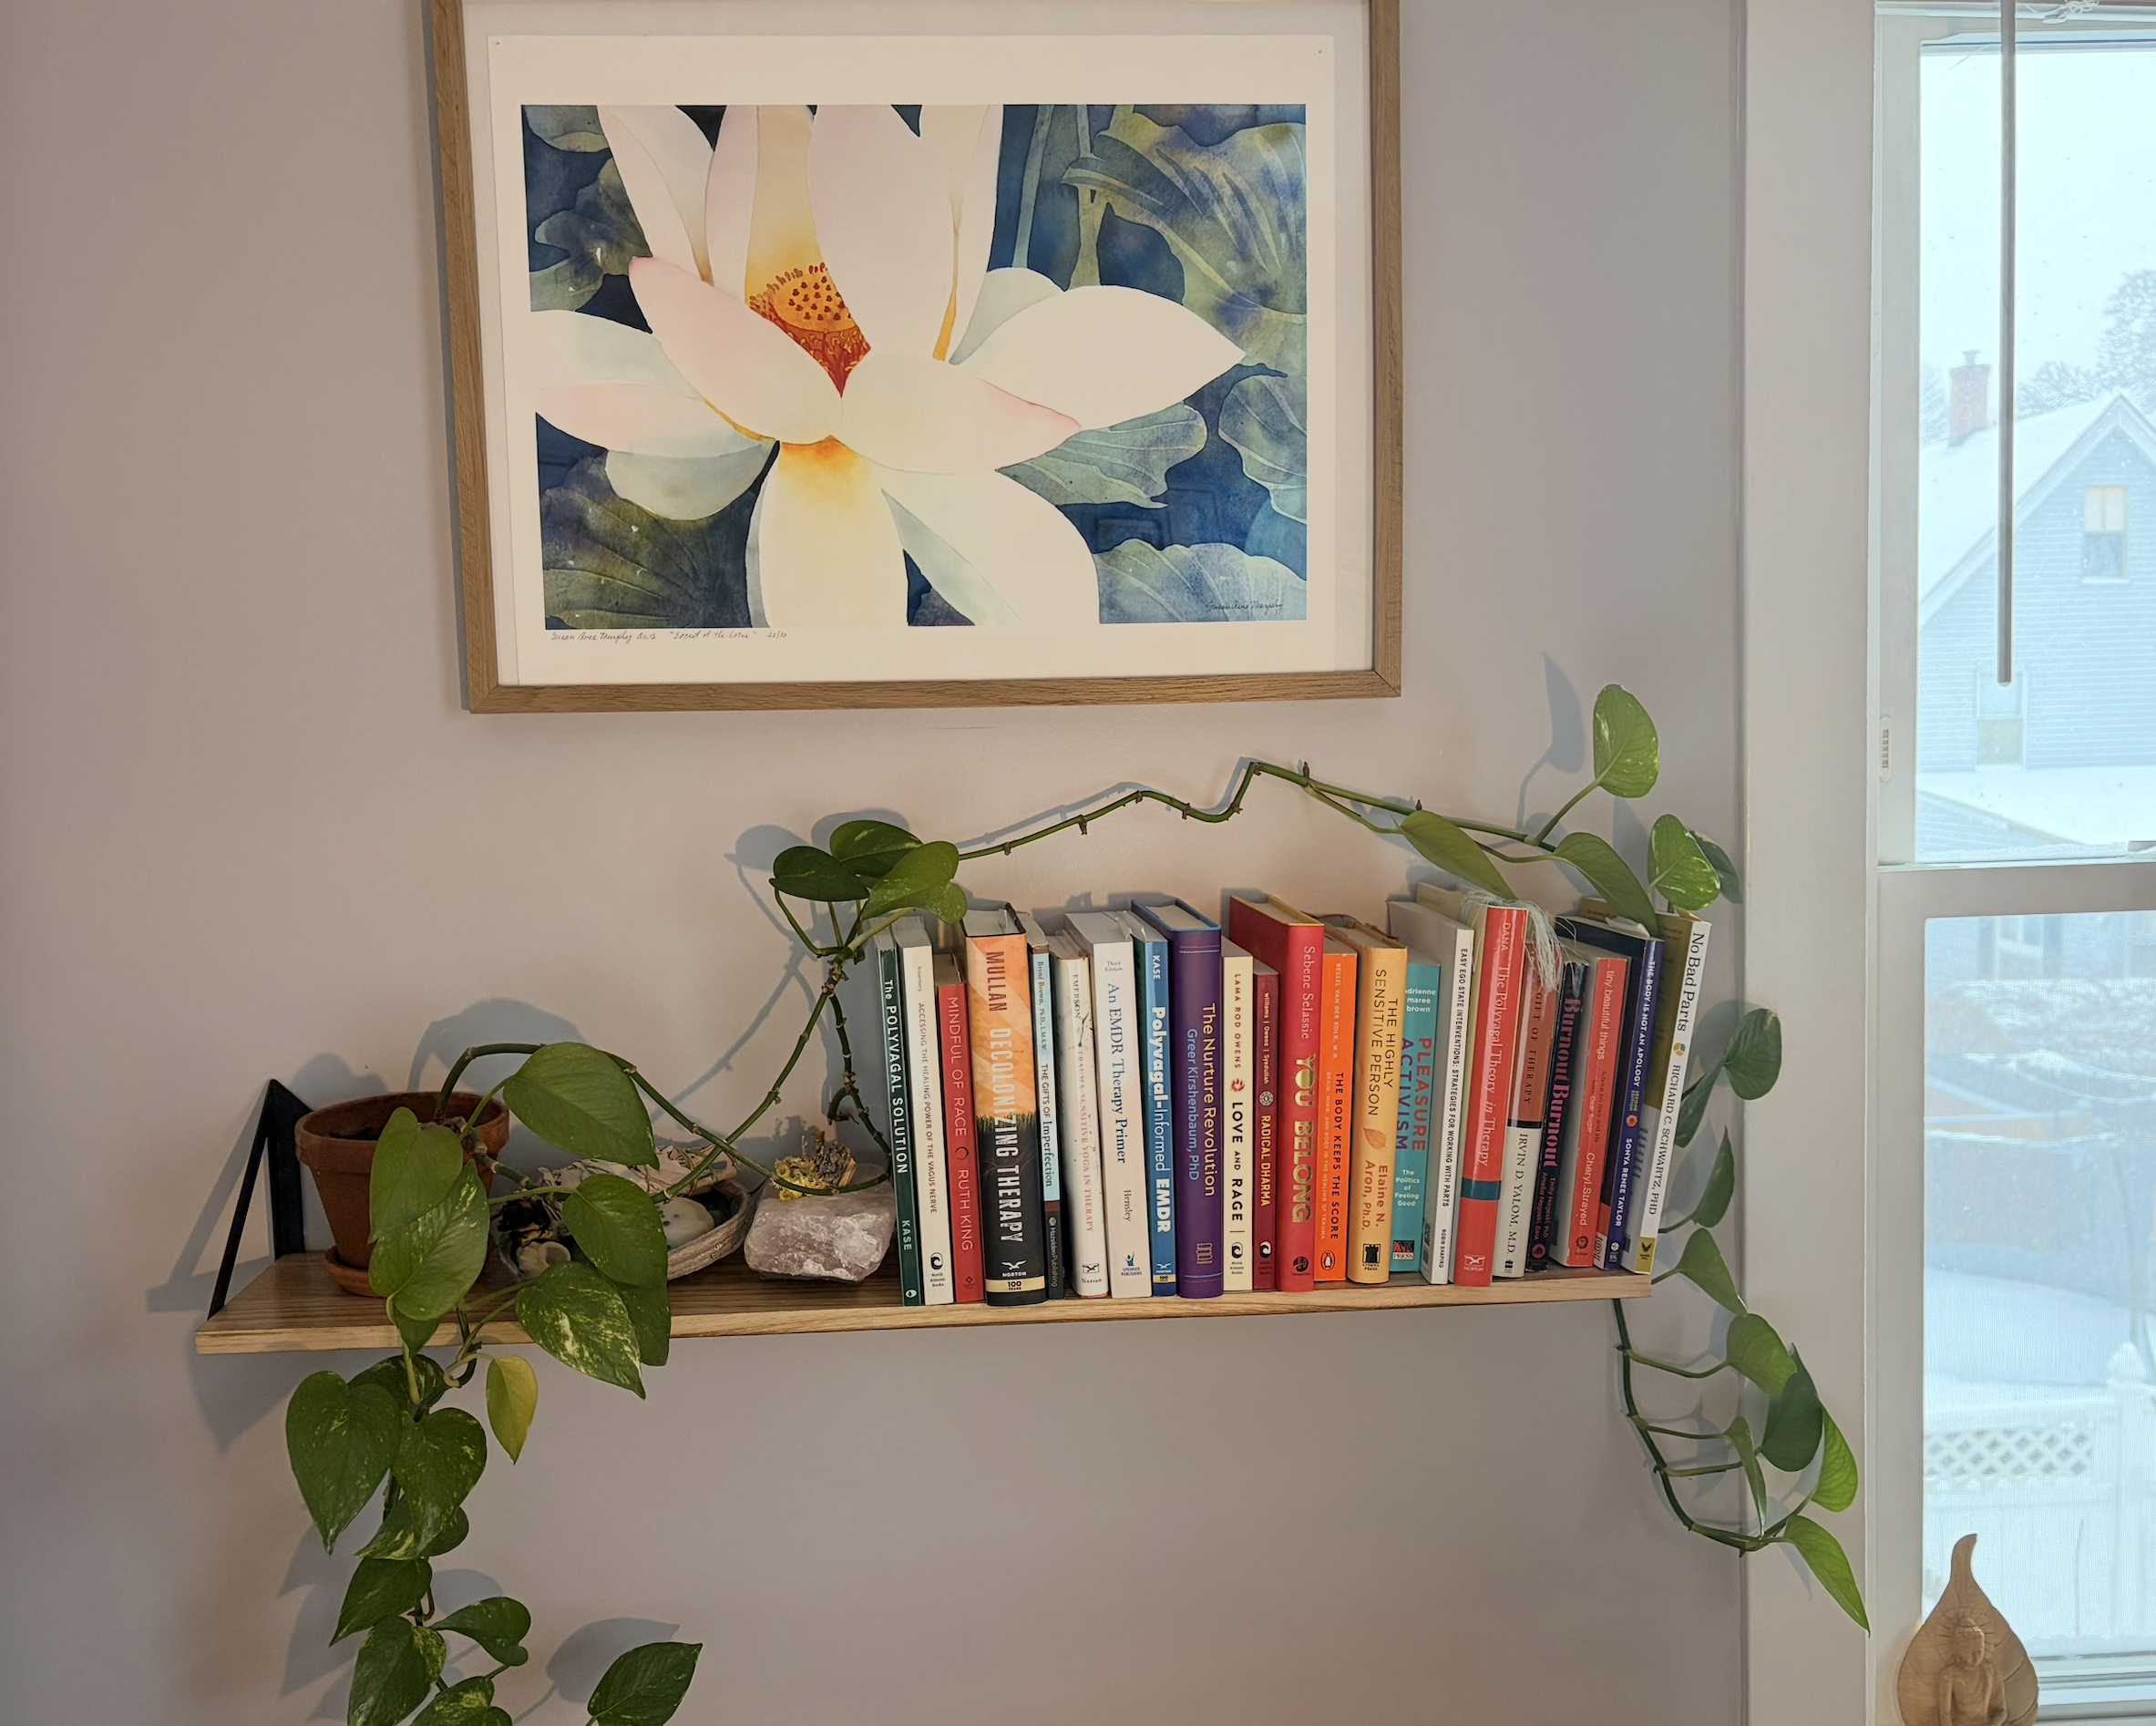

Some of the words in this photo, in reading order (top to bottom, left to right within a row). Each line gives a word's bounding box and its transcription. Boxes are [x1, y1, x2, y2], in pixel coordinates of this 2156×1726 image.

[1500, 921, 1511, 951] DANA
[1689, 932, 1705, 954] No
[1152, 954, 1161, 980] KASE
[1302, 946, 1316, 989] Sebene
[1460, 948, 1468, 968] EASY
[1496, 962, 1510, 989] The
[1648, 960, 1656, 978] THE
[1685, 957, 1700, 987] Bad
[883, 980, 894, 1000] The
[986, 951, 1007, 1012] MULLAN
[1107, 982, 1120, 1003] An
[1458, 969, 1466, 984] EGO
[1604, 970, 1616, 988] tiny
[1644, 978, 1653, 1002] BODY
[1073, 974, 1082, 1019] EMERSON
[1371, 969, 1387, 1048] SENSITIVE
[1386, 998, 1399, 1027] THE
[1456, 986, 1465, 1008] STATE
[1534, 992, 1543, 1020] GIFT
[1601, 989, 1614, 1030] beautiful
[1643, 1003, 1650, 1012] IS
[1677, 990, 1695, 1033] Parts
[918, 1002, 928, 1046] ACCESSING
[948, 997, 962, 1064] MINDFUL
[1109, 1007, 1124, 1054] EMDR
[1203, 1002, 1217, 1035] The
[1300, 992, 1315, 1040] Selassie
[1488, 992, 1508, 1047] Polyvagal
[1640, 1013, 1649, 1032] NOT
[886, 1005, 902, 1093] POLYVAGAL
[1187, 1028, 1197, 1064] Greer
[1453, 1009, 1463, 1067] INTERVENTIONS:
[1532, 1027, 1539, 1043] OF
[1554, 998, 1581, 1084] Burnout
[1596, 1032, 1608, 1060] things
[1638, 1033, 1646, 1046] AN
[920, 1048, 929, 1063] THE
[1041, 1063, 1049, 1080] THE
[1203, 1038, 1217, 1104] Nurture
[1383, 1033, 1396, 1088] HIGHLY
[1484, 1050, 1503, 1094] Theory
[1633, 1046, 1645, 1087] APOLOGY
[922, 1063, 930, 1100] HEALING
[951, 1069, 964, 1089] OF
[989, 1027, 1019, 1157] DECOLONIZING
[1042, 1082, 1050, 1105] GIFTS
[1111, 1058, 1125, 1114] Therapy
[1148, 1006, 1171, 1172] Polyvagal-Informed
[1294, 1053, 1316, 1107] YOU
[1335, 1072, 1344, 1094] THE
[1368, 1053, 1381, 1115] PERSON
[1396, 1037, 1414, 1150] ACTIVISM
[1450, 1069, 1459, 1112] STRATEGIES
[1524, 1049, 1537, 1104] THERAPY
[1666, 1064, 1681, 1114] RICHARD
[1042, 1106, 1051, 1118] OF
[1186, 1066, 1199, 1152] Kirshenbaum,
[1412, 1038, 1432, 1151] PLEASURE
[1484, 1100, 1496, 1114] in
[924, 1101, 932, 1130] POWER
[953, 1097, 967, 1137] RACE
[1232, 1102, 1243, 1144] LOVE
[1334, 1099, 1343, 1130] BODY
[1448, 1114, 1456, 1128] FOR
[1543, 1084, 1570, 1167] Burnout
[1664, 1117, 1672, 1127] C.
[892, 1097, 909, 1174] SOLUTION
[926, 1131, 933, 1142] OF
[1115, 1118, 1128, 1164] Primer
[1204, 1107, 1218, 1197] Revolution
[1261, 1115, 1271, 1160] RADICAL
[1332, 1135, 1341, 1170] KEEPS
[1445, 1130, 1454, 1163] WORKING
[1477, 1116, 1496, 1167] Therapy
[1516, 1133, 1528, 1166] IRVIN
[1623, 1138, 1633, 1166] SONYA
[1042, 1120, 1054, 1187] Imperfection
[1082, 1145, 1091, 1173] YOGA
[1188, 1155, 1200, 1181] PhD
[1582, 1152, 1596, 1185] Cheryl
[1651, 1127, 1670, 1190] SCHWARTZ,
[928, 1160, 936, 1187] VAGUS
[958, 1169, 970, 1209] RUTH
[1084, 1175, 1091, 1185] IN
[1260, 1162, 1271, 1207] DHARMA
[1292, 1120, 1314, 1224] BELONG
[1331, 1176, 1340, 1197] THE
[1361, 1160, 1376, 1197] Aron,
[1376, 1166, 1388, 1207] Elaine
[1443, 1165, 1453, 1183] WITH
[1514, 1170, 1525, 1181] D.
[1618, 1167, 1629, 1194] RENEE
[929, 1188, 938, 1214] NERVE
[997, 1165, 1023, 1242] THERAPY
[1084, 1188, 1093, 1233] THERAPY
[1123, 1189, 1133, 1222] Hensley
[1155, 1178, 1171, 1233] EMDR
[1231, 1178, 1243, 1221] RAGE
[1442, 1185, 1451, 1207] PARTS
[1509, 1184, 1523, 1228] YALOM,
[1579, 1187, 1592, 1226] Strayed
[1615, 1195, 1626, 1227] TAYLOR
[1649, 1193, 1659, 1215] PHD
[960, 1214, 973, 1251] KING
[1330, 1202, 1340, 1239] SCORE
[1361, 1202, 1371, 1230] Ph.D.
[1375, 1213, 1385, 1227] N.
[901, 1219, 912, 1251] KASE
[1506, 1231, 1517, 1255] M.D.
